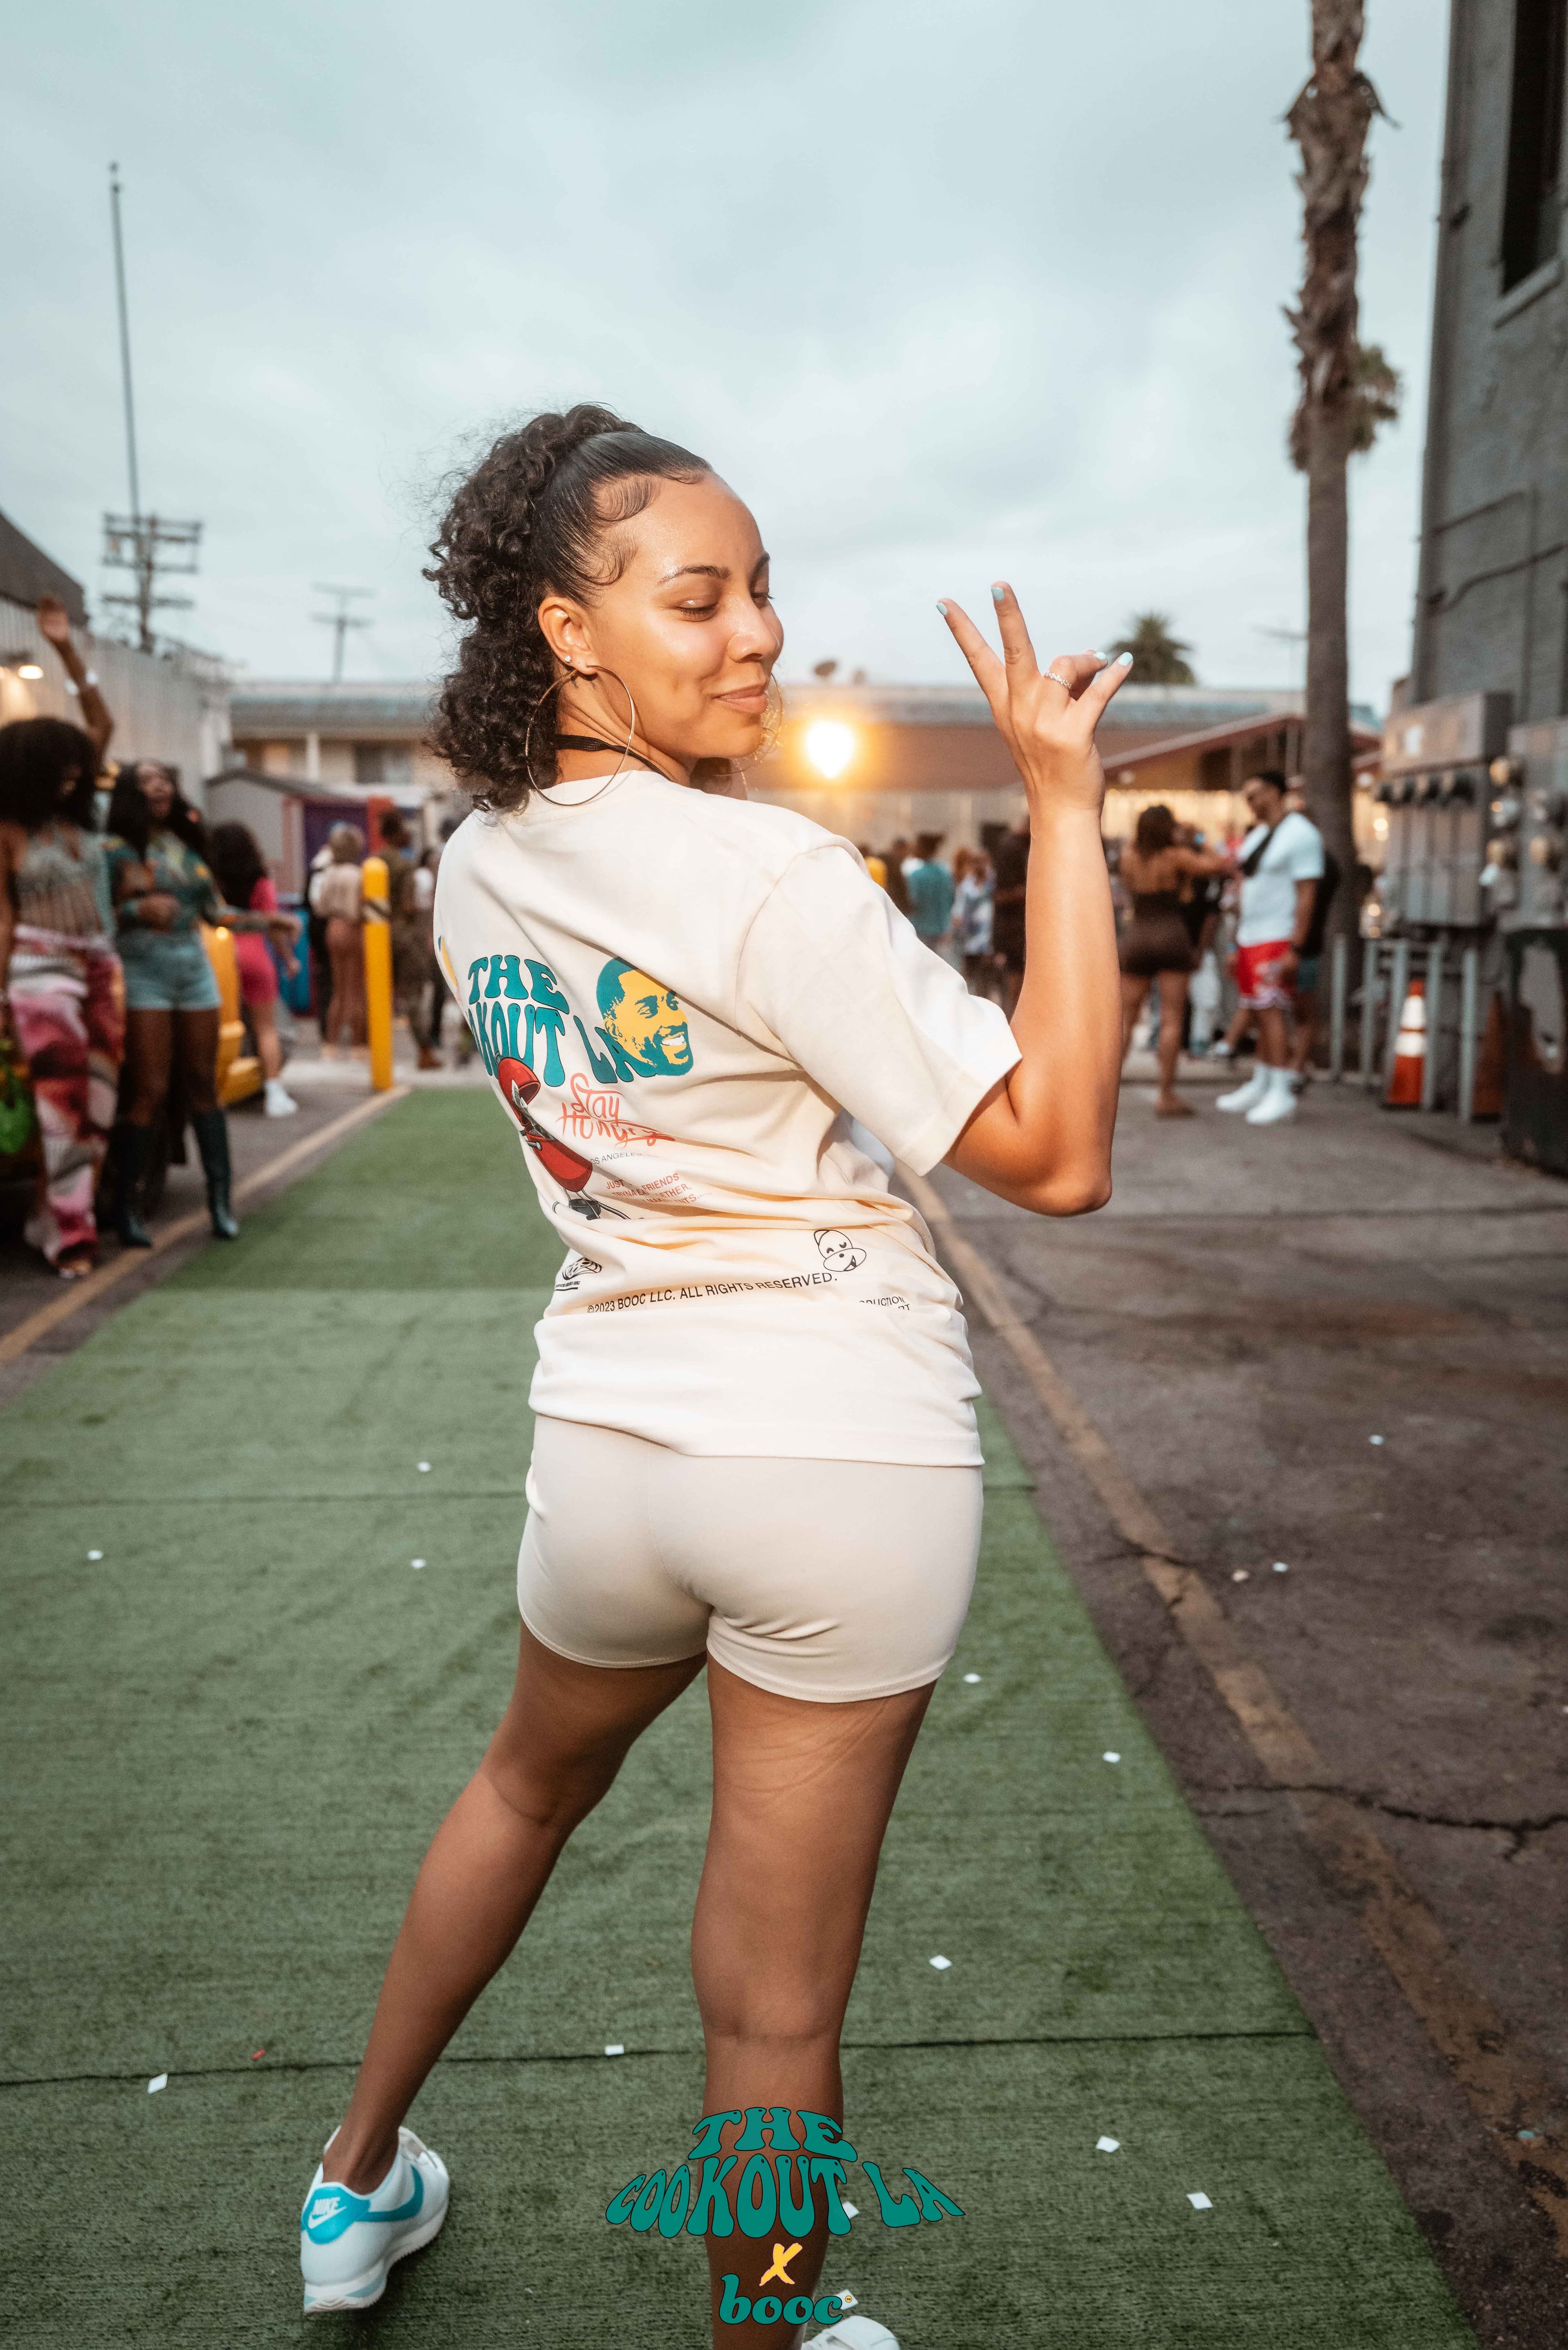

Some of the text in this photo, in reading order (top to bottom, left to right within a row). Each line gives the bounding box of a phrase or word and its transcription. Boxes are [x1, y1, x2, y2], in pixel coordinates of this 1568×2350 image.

[468, 954, 570, 1014] THE
[573, 1015, 657, 1084] LA
[570, 1072, 625, 1127] Stay
[606, 1173, 679, 1191] JUST FRIENDS
[618, 1293, 646, 1309] BOOC
[650, 1289, 675, 1302] LLC.
[680, 1285, 703, 1299] ALL
[705, 1283, 754, 1296] RIGHTS
[755, 1273, 837, 1289] RESERVED.
